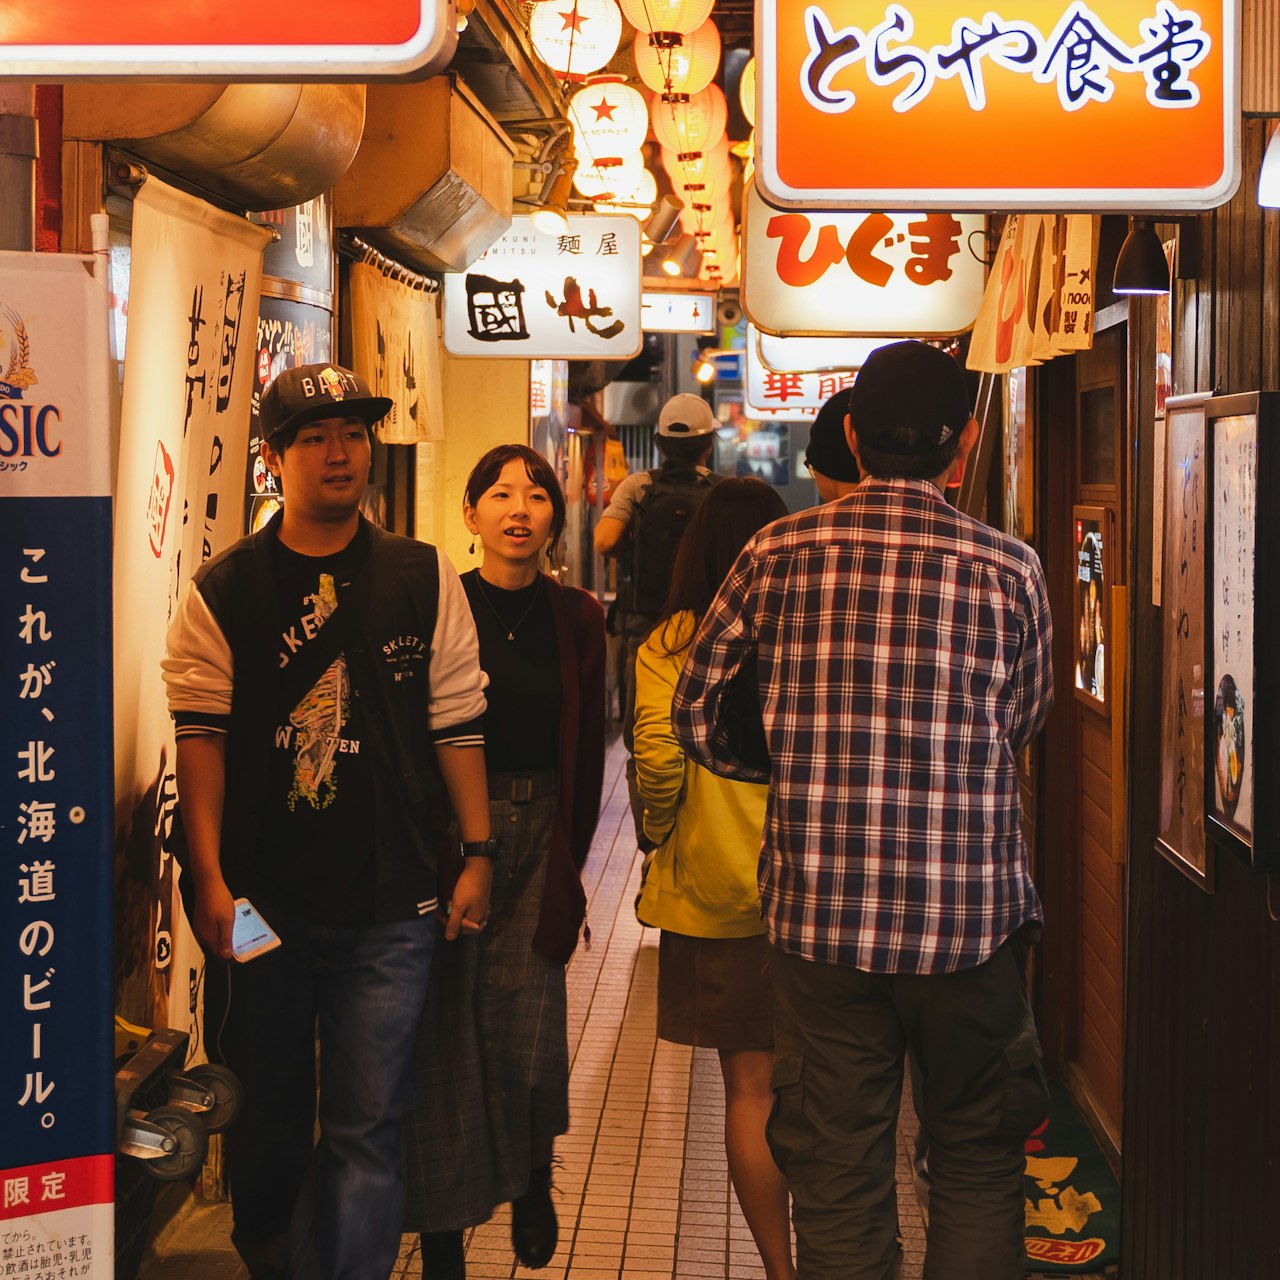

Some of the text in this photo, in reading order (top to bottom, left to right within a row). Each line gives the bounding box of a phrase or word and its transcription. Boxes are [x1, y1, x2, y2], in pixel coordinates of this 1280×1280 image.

[802, 0, 1212, 113] とらや食堂
[556, 232, 619, 256] 麺屋
[766, 213, 963, 288] ひぐま
[301, 371, 359, 397] BART
[17, 548, 57, 1129] これが、北海道のビール。
